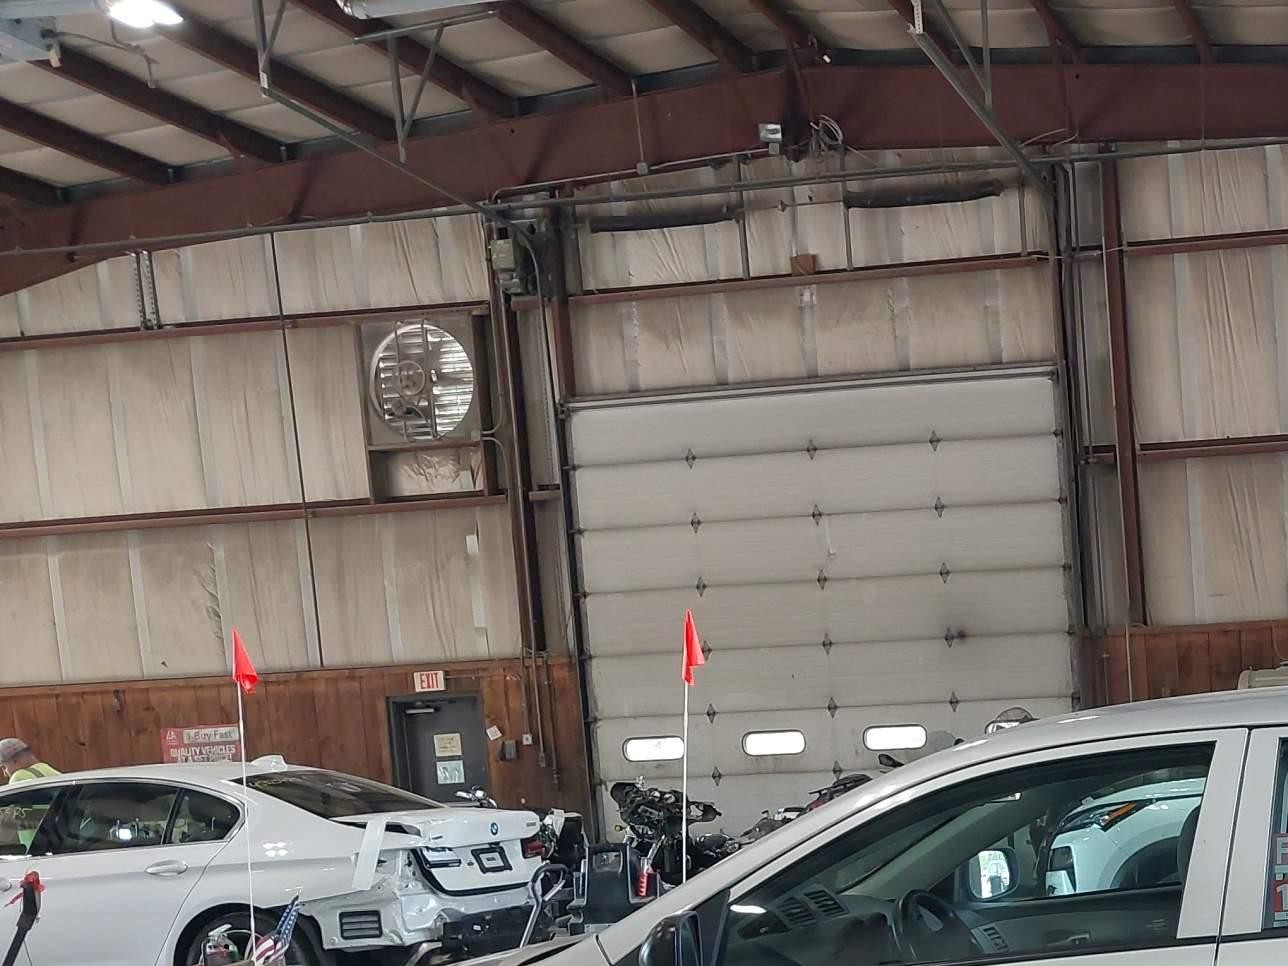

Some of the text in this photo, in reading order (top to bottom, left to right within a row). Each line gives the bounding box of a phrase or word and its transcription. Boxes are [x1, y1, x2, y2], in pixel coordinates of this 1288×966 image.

[420, 673, 439, 689] EXIT
[170, 744, 236, 757] QUALITY VEHICLES
